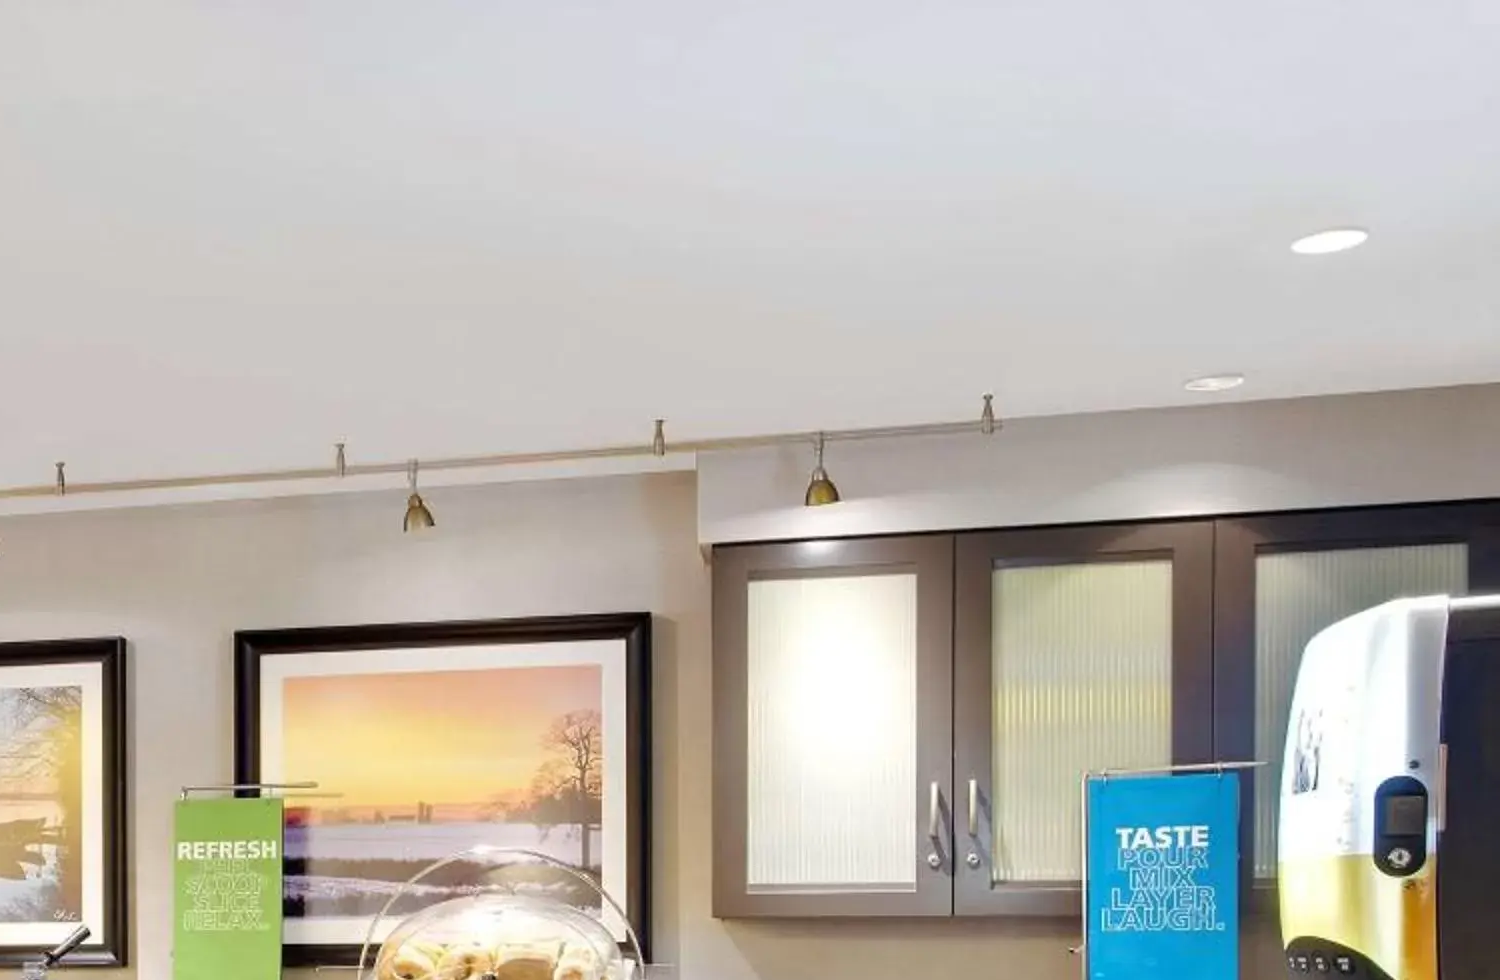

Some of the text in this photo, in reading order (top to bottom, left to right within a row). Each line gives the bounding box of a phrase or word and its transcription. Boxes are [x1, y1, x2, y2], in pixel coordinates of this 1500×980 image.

[1115, 824, 1209, 850] TASTE
[177, 840, 277, 860] REFRESH
[1117, 846, 1209, 870] POUR
[1130, 866, 1195, 890] MIX
[1111, 886, 1216, 910] LAYER
[1101, 907, 1225, 932] LAUGH.
